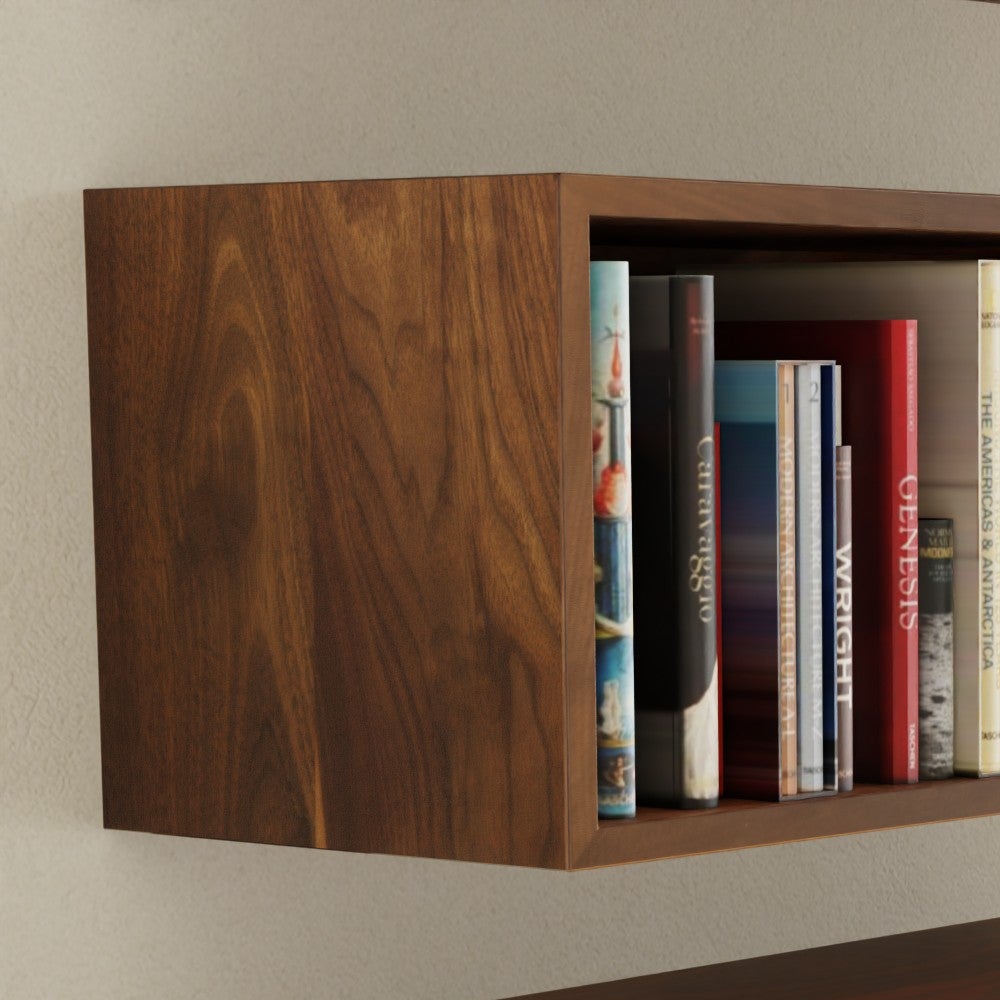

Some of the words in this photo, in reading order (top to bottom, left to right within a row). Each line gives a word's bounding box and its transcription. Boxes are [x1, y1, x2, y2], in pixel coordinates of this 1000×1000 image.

[809, 382, 820, 403] 2
[982, 392, 993, 428] THE
[686, 436, 714, 623] Caravaggio
[981, 434, 994, 532] AMERICAS
[899, 474, 917, 629] GENESIS
[982, 539, 994, 551] &
[837, 541, 852, 709] WRIGHT
[981, 557, 995, 670] ANTARCTICA
[908, 724, 917, 769] TASCHEN
